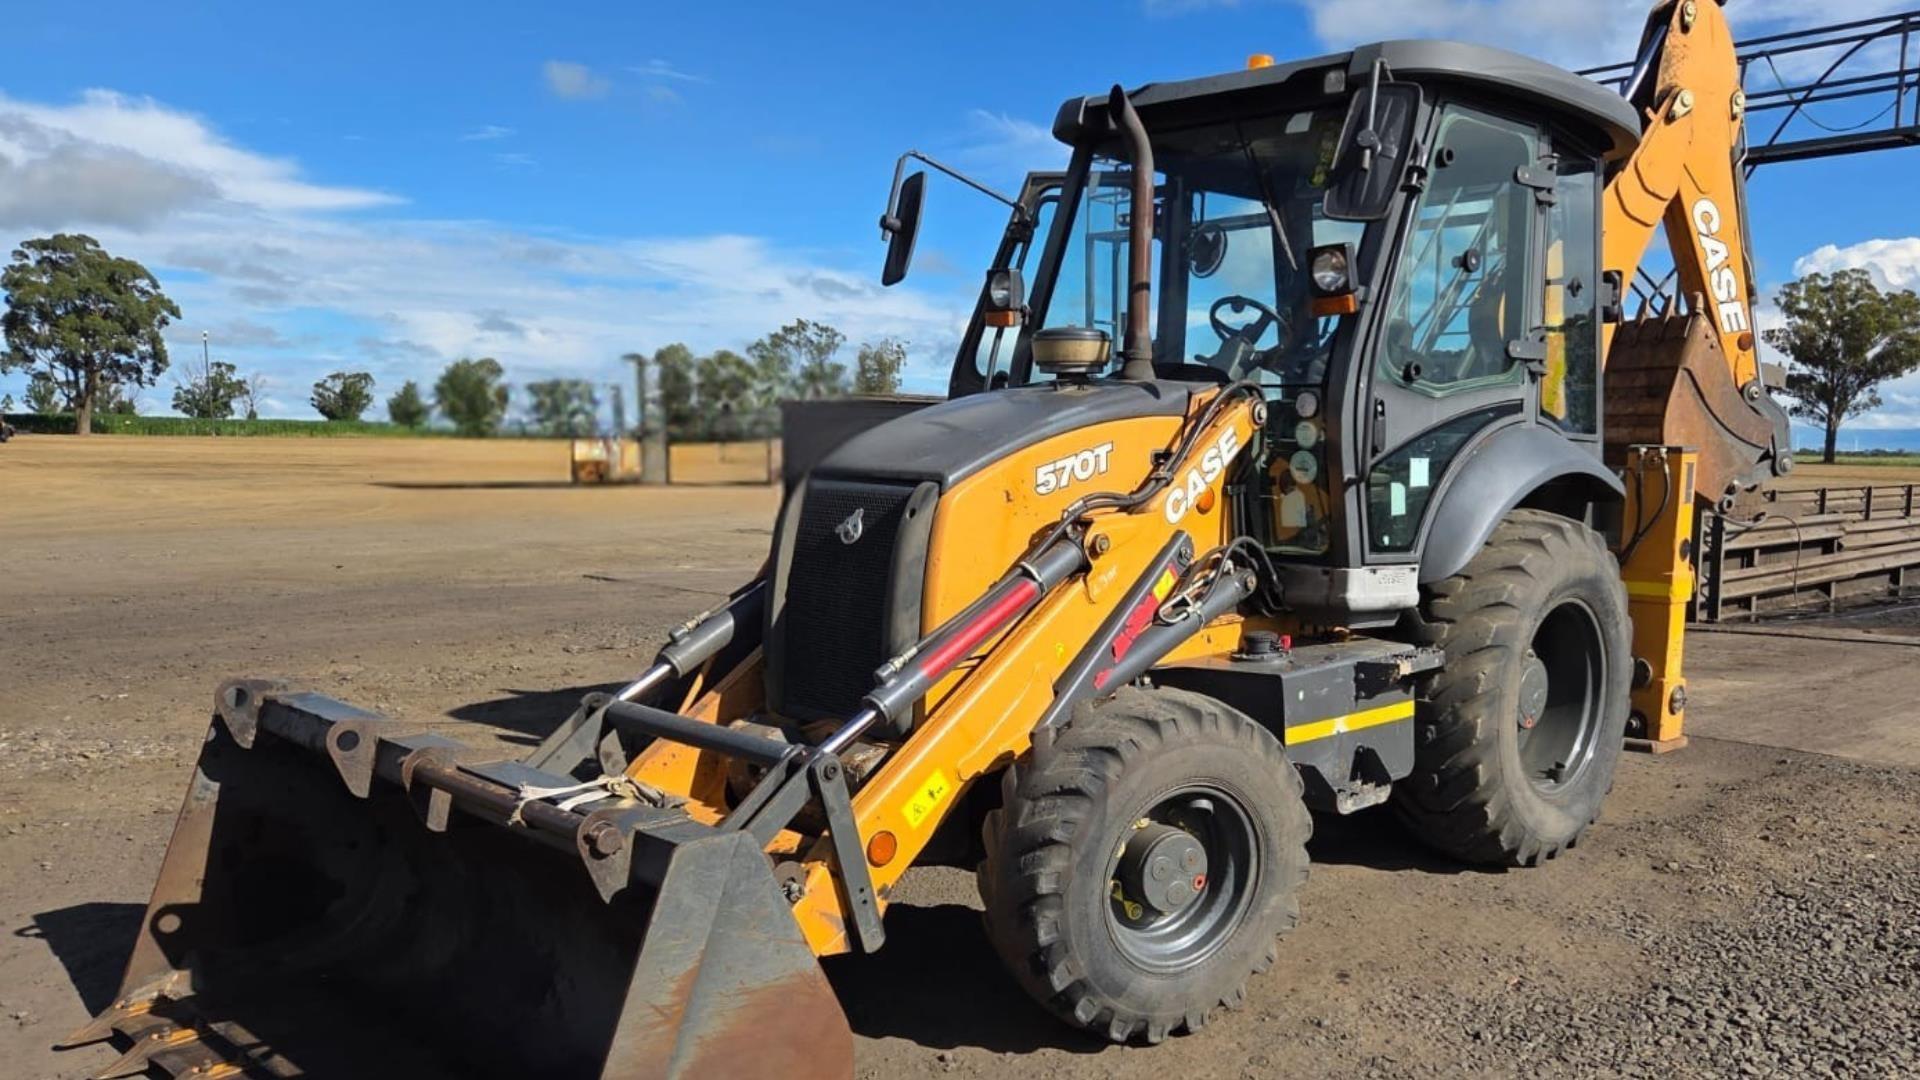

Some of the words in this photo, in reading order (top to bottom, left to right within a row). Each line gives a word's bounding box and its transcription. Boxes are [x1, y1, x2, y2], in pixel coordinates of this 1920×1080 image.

[1692, 198, 1748, 333] CASE
[1035, 441, 1113, 494] 570T
[1165, 427, 1239, 523] CASE
